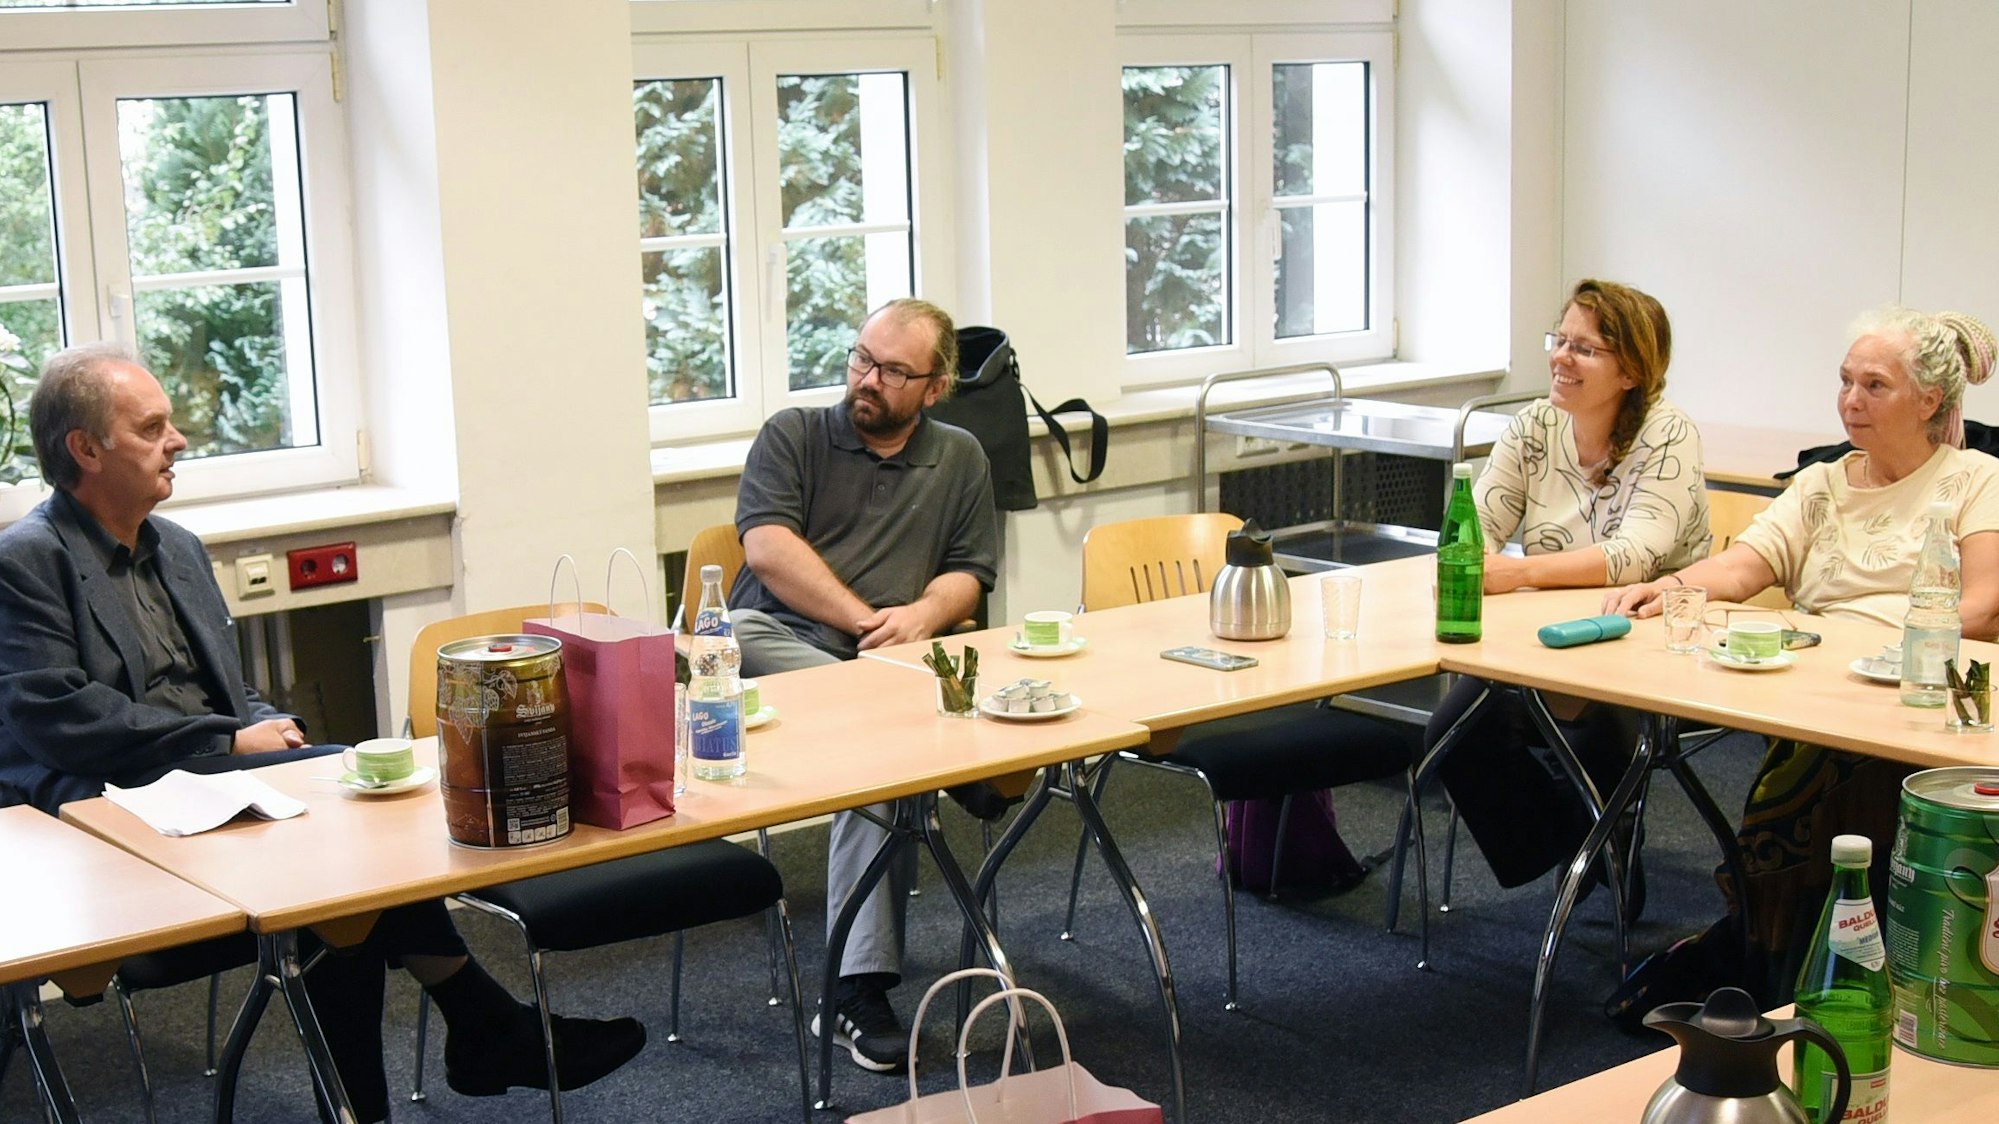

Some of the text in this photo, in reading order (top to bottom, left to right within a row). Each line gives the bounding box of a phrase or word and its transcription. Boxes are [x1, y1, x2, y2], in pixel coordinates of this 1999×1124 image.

[694, 616, 720, 634] LAGO
[692, 711, 710, 722] LAGO
[1838, 910, 1875, 930] BALDU
[1853, 918, 1877, 932] QUELL
[1937, 951, 1949, 974] pivo
[1939, 976, 1950, 995] bez
